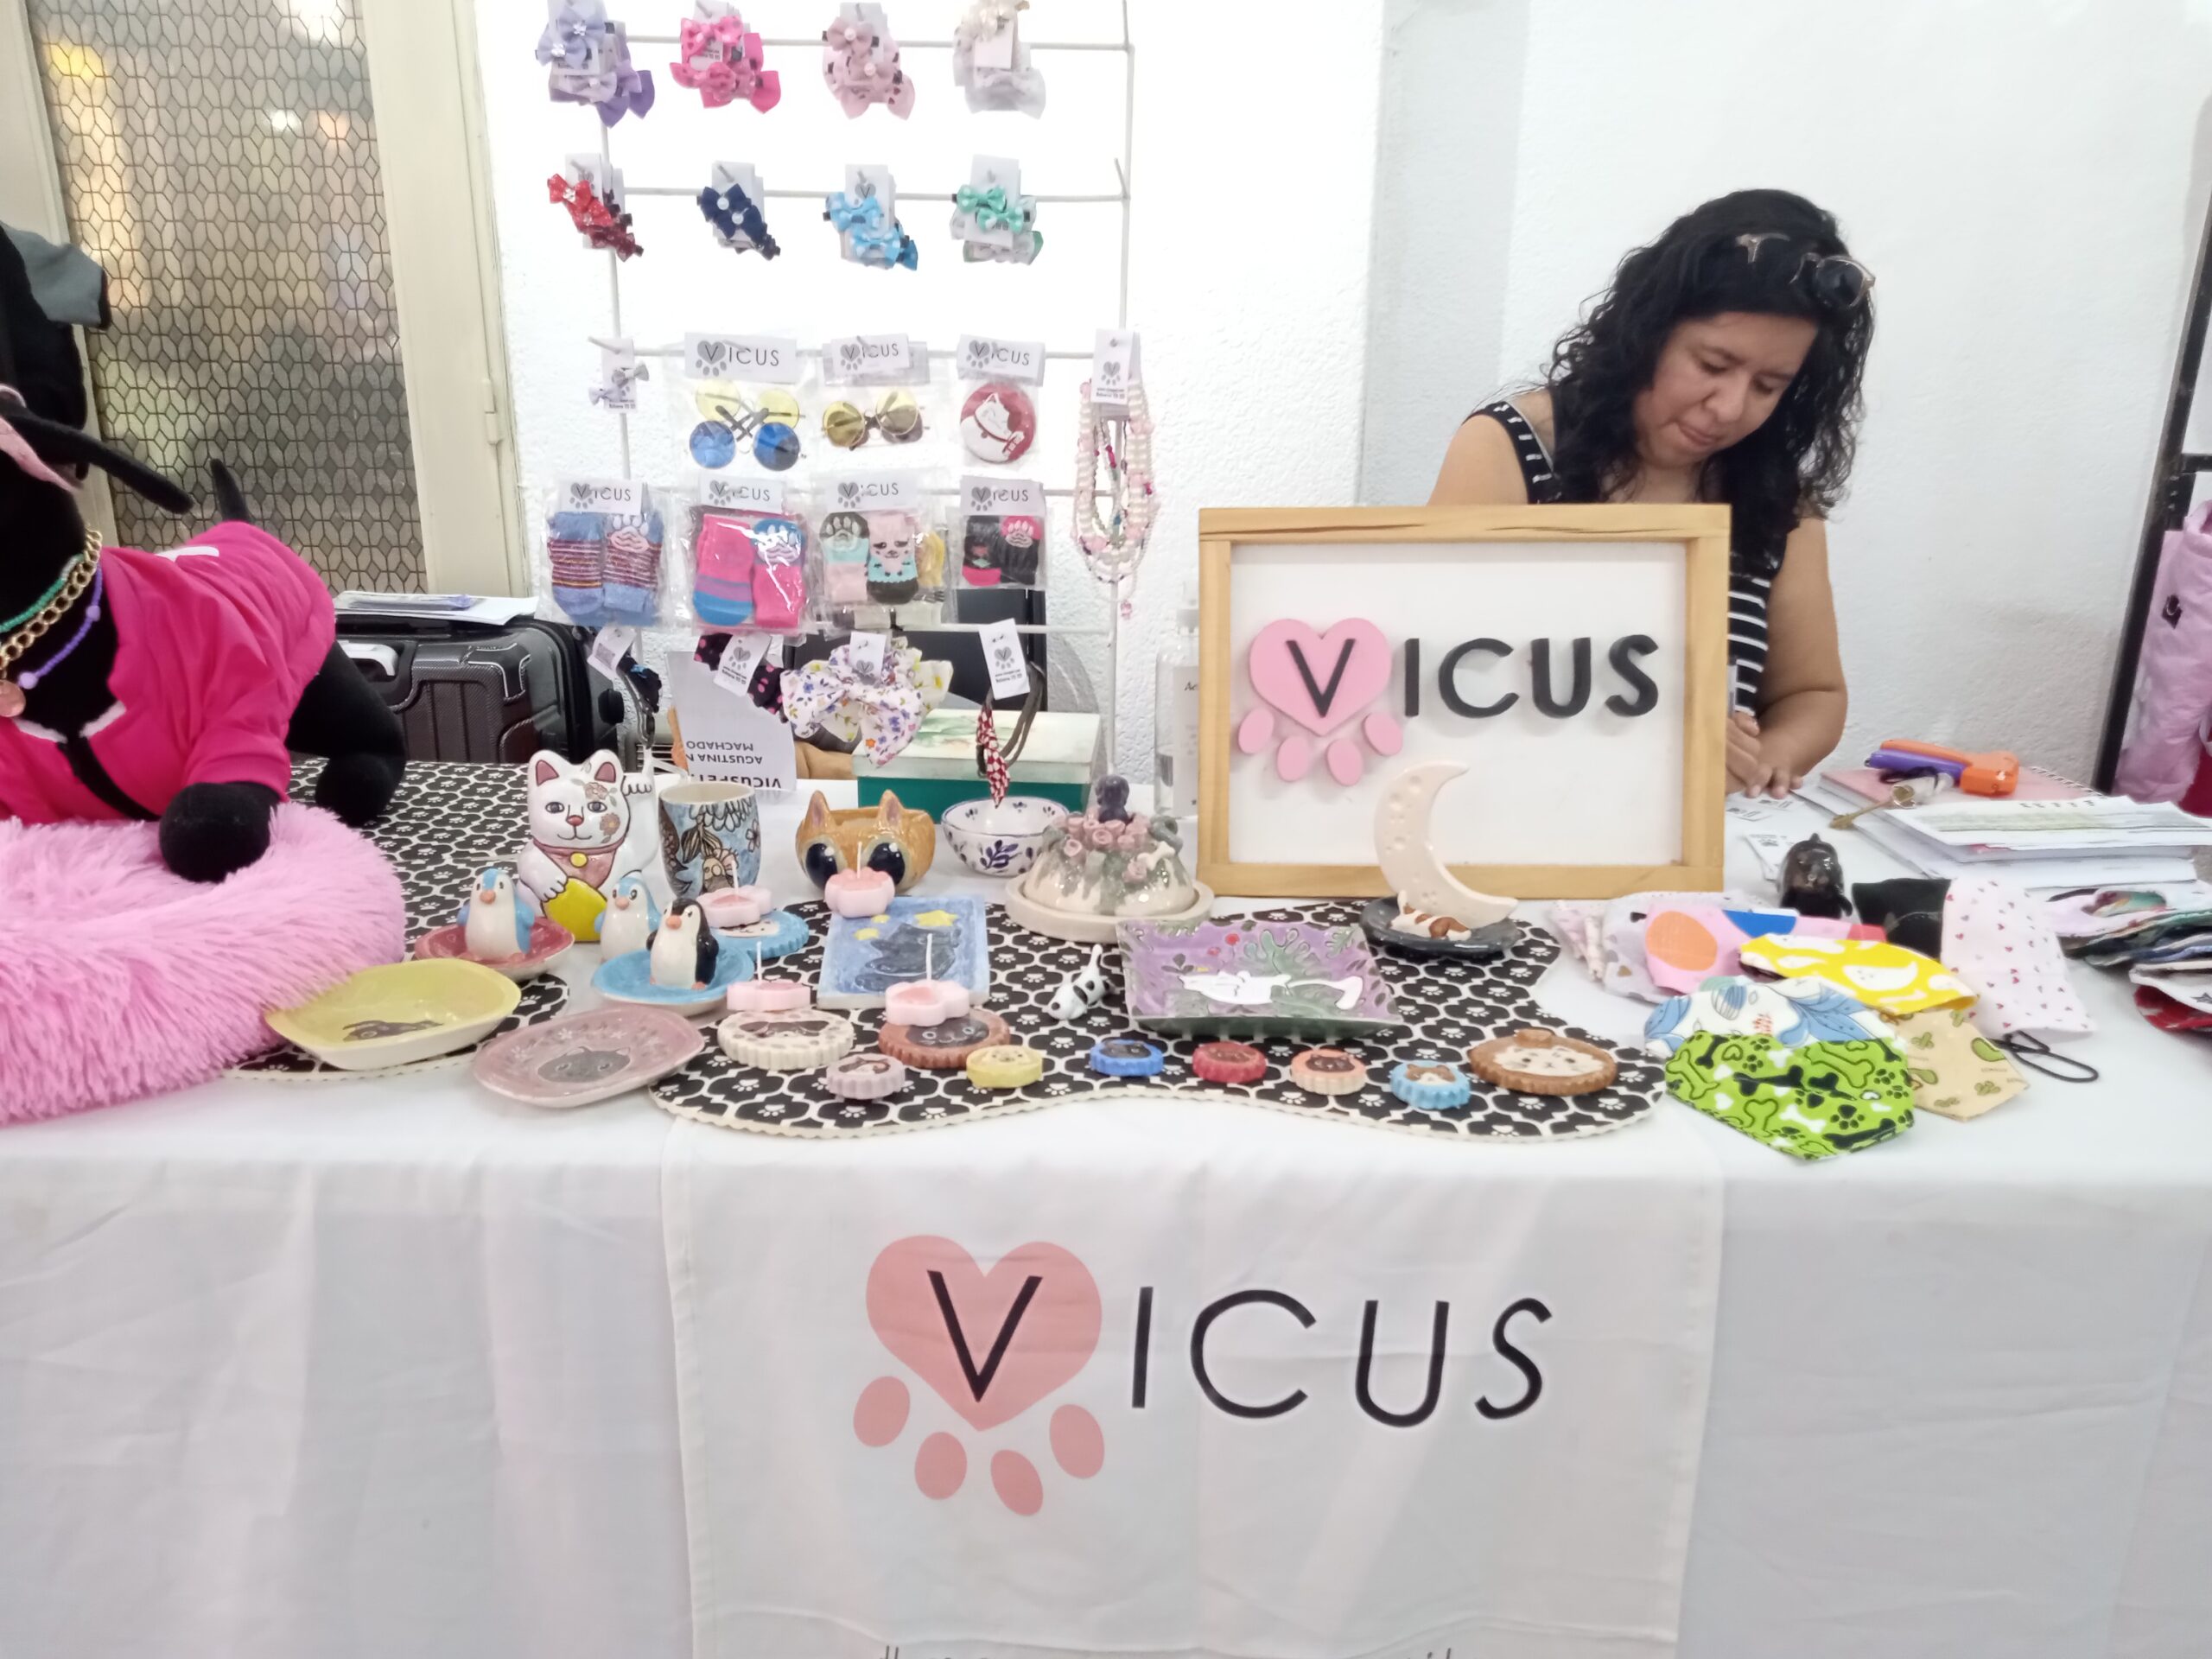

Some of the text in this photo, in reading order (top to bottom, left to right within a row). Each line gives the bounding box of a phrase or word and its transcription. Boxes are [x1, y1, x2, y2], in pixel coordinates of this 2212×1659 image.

[704, 344, 779, 367] VICUS
[845, 343, 899, 359] VICUS
[1286, 634, 1659, 719] VICUS
[685, 741, 753, 751] MACHADO
[697, 753, 762, 765] AGUSTINA
[927, 1269, 1552, 1428] VICUS
